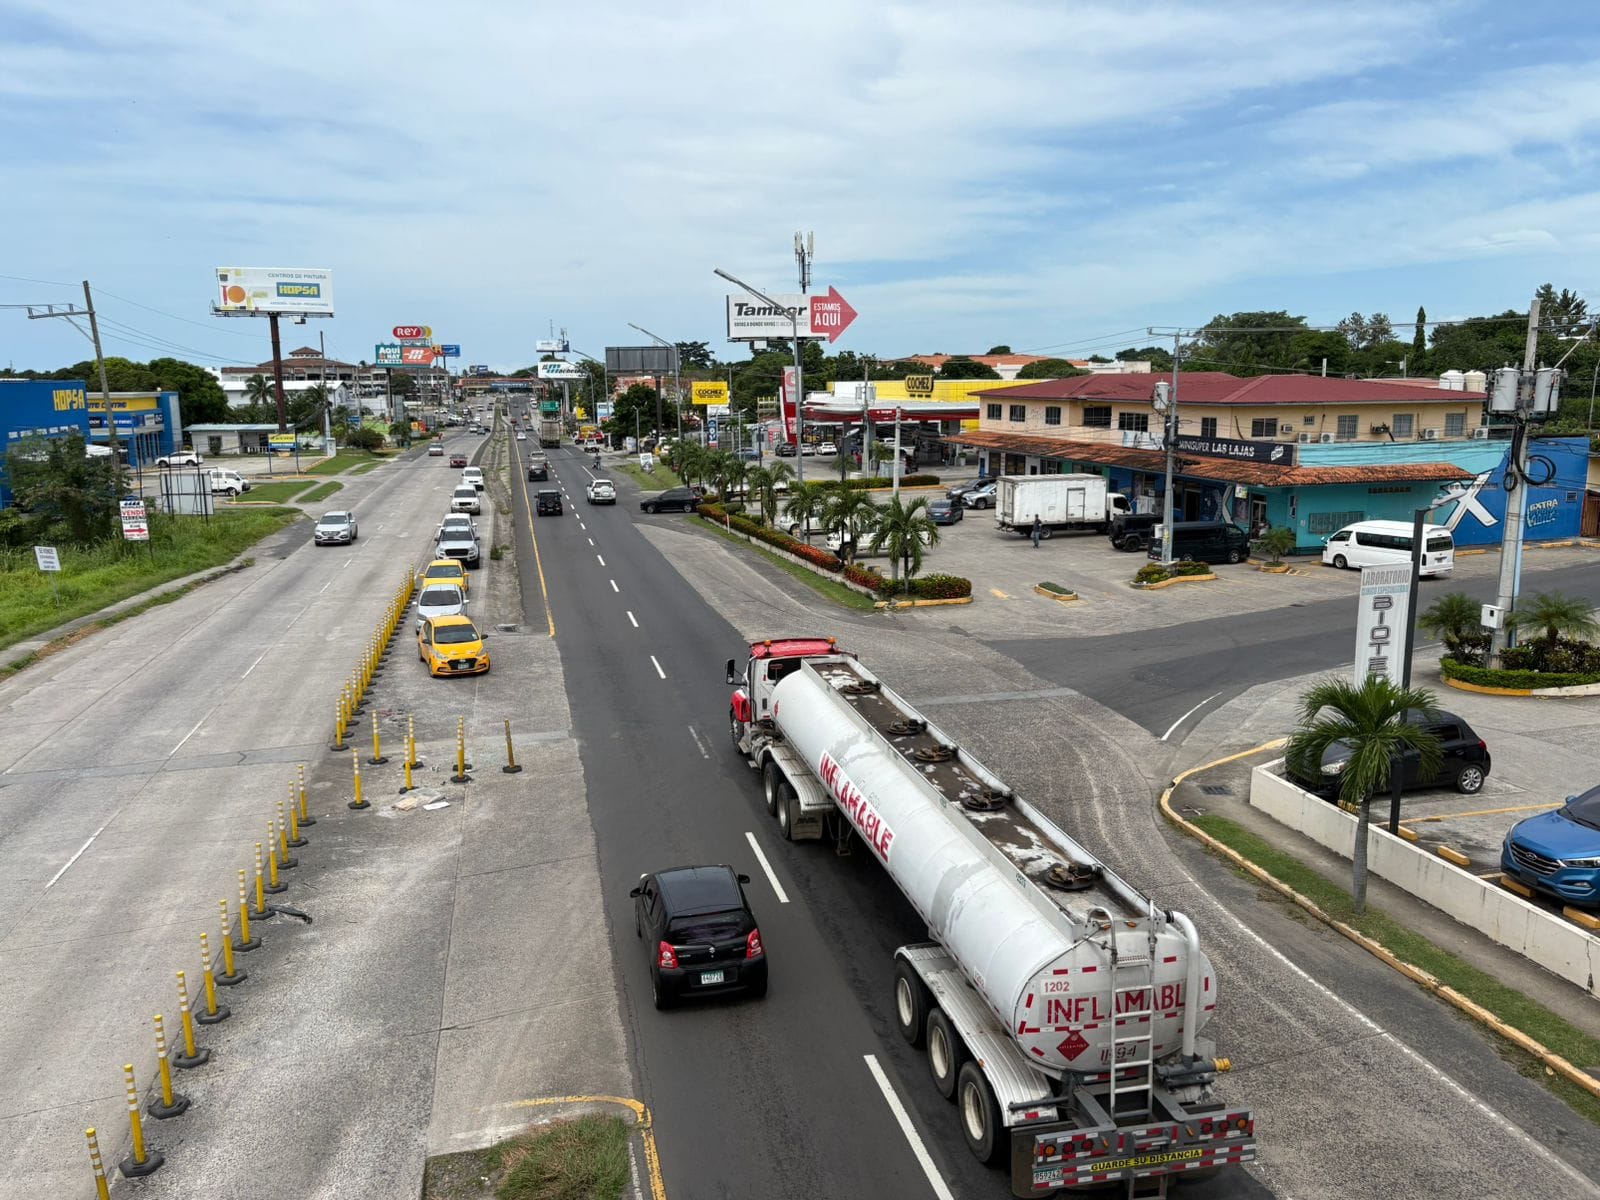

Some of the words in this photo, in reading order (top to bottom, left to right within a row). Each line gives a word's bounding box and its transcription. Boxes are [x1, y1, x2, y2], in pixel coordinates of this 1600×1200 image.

[279, 285, 318, 295] HOPSA
[814, 303, 841, 312] ESTAMOS
[907, 376, 931, 390] COCHEZ
[53, 389, 85, 411] HOPSA
[1211, 442, 1227, 453] LAS
[1228, 444, 1255, 457] LAJAS
[1362, 569, 1410, 586] LABORATORIO
[820, 752, 894, 863] INFLAMABLE
[1044, 982, 1070, 992] 1202
[1091, 1160, 1131, 1172] GUARDE
[1133, 1157, 1147, 1165] SU
[1150, 1149, 1201, 1163] DISTANCIA
